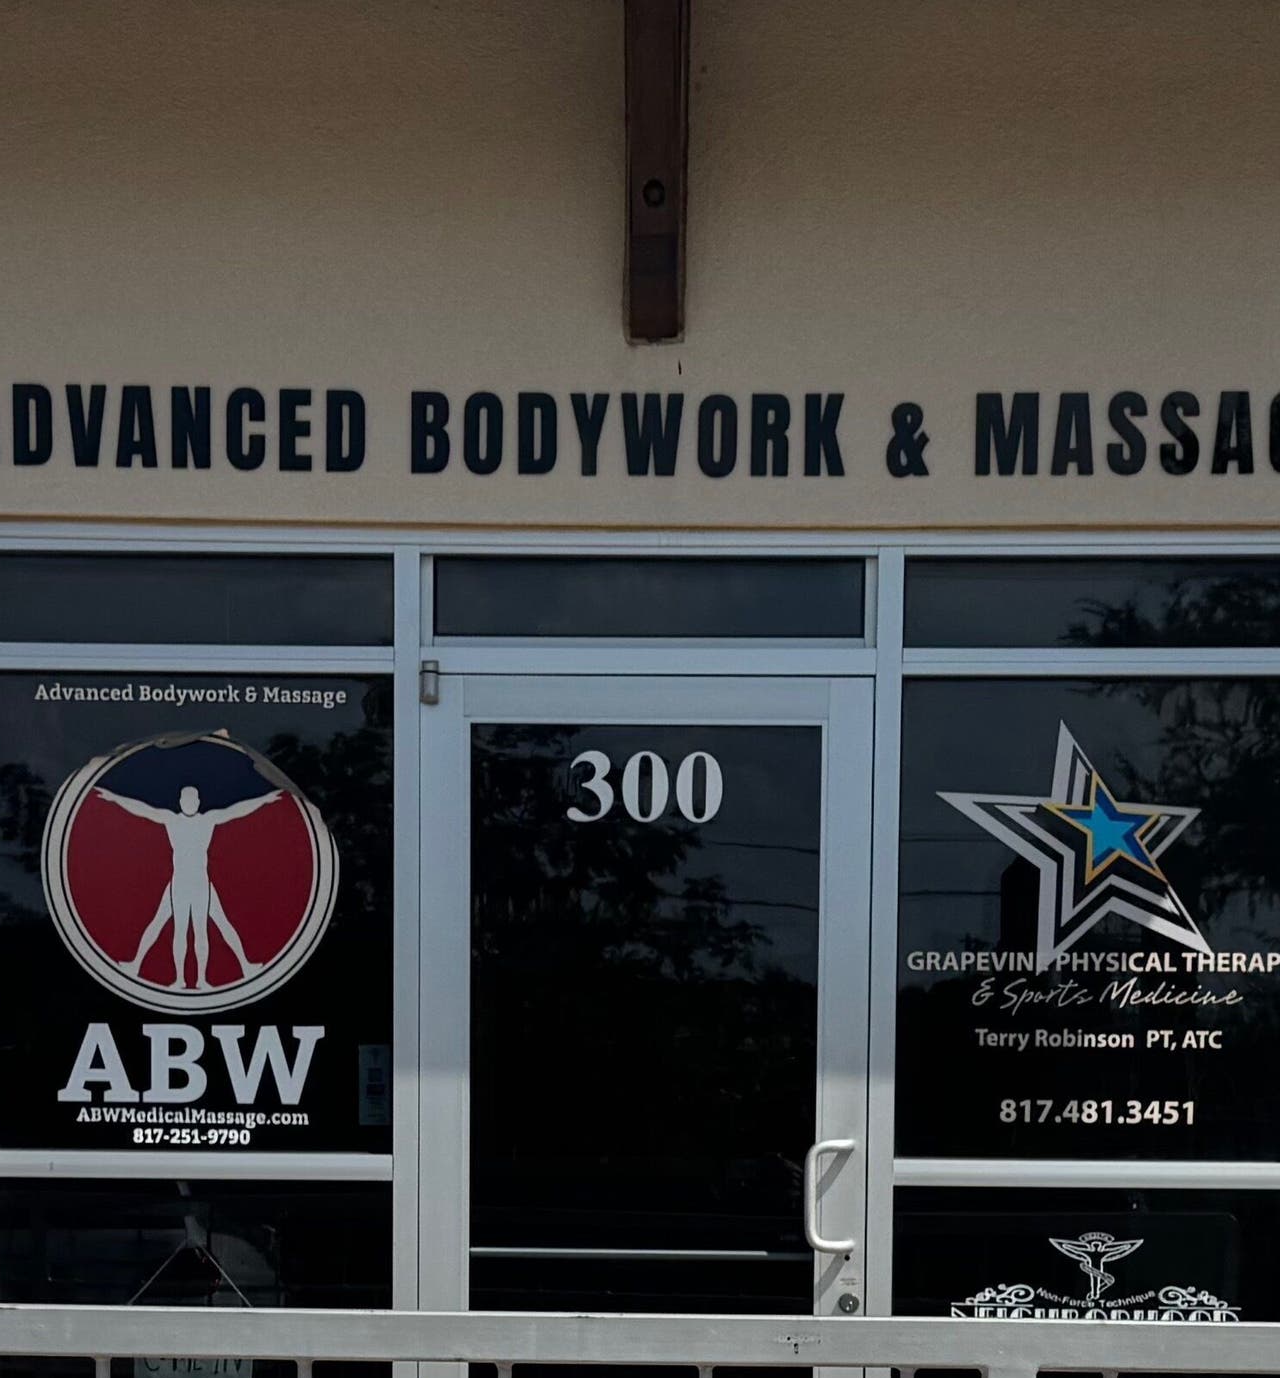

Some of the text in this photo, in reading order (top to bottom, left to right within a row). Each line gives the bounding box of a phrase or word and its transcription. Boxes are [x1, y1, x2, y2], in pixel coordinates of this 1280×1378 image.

[410, 390, 846, 479] BODYWORK
[885, 401, 931, 479] &
[34, 682, 347, 709] Advanced Bodywork & Massage
[566, 750, 723, 824] 300
[906, 950, 1050, 972] GRAPEVIN
[1056, 950, 1178, 973] PHYSICAL
[971, 976, 1244, 1016] & Sports Medicine
[975, 1028, 1223, 1051] Terry Robinson PT, ATC
[57, 1022, 325, 1105] ABW
[76, 1107, 309, 1128] ABWMedicalMassage.com
[999, 1099, 1194, 1125] 817.481.3451
[132, 1127, 251, 1145] 817-251-9790
[1098, 1289, 1157, 1309] Technique
